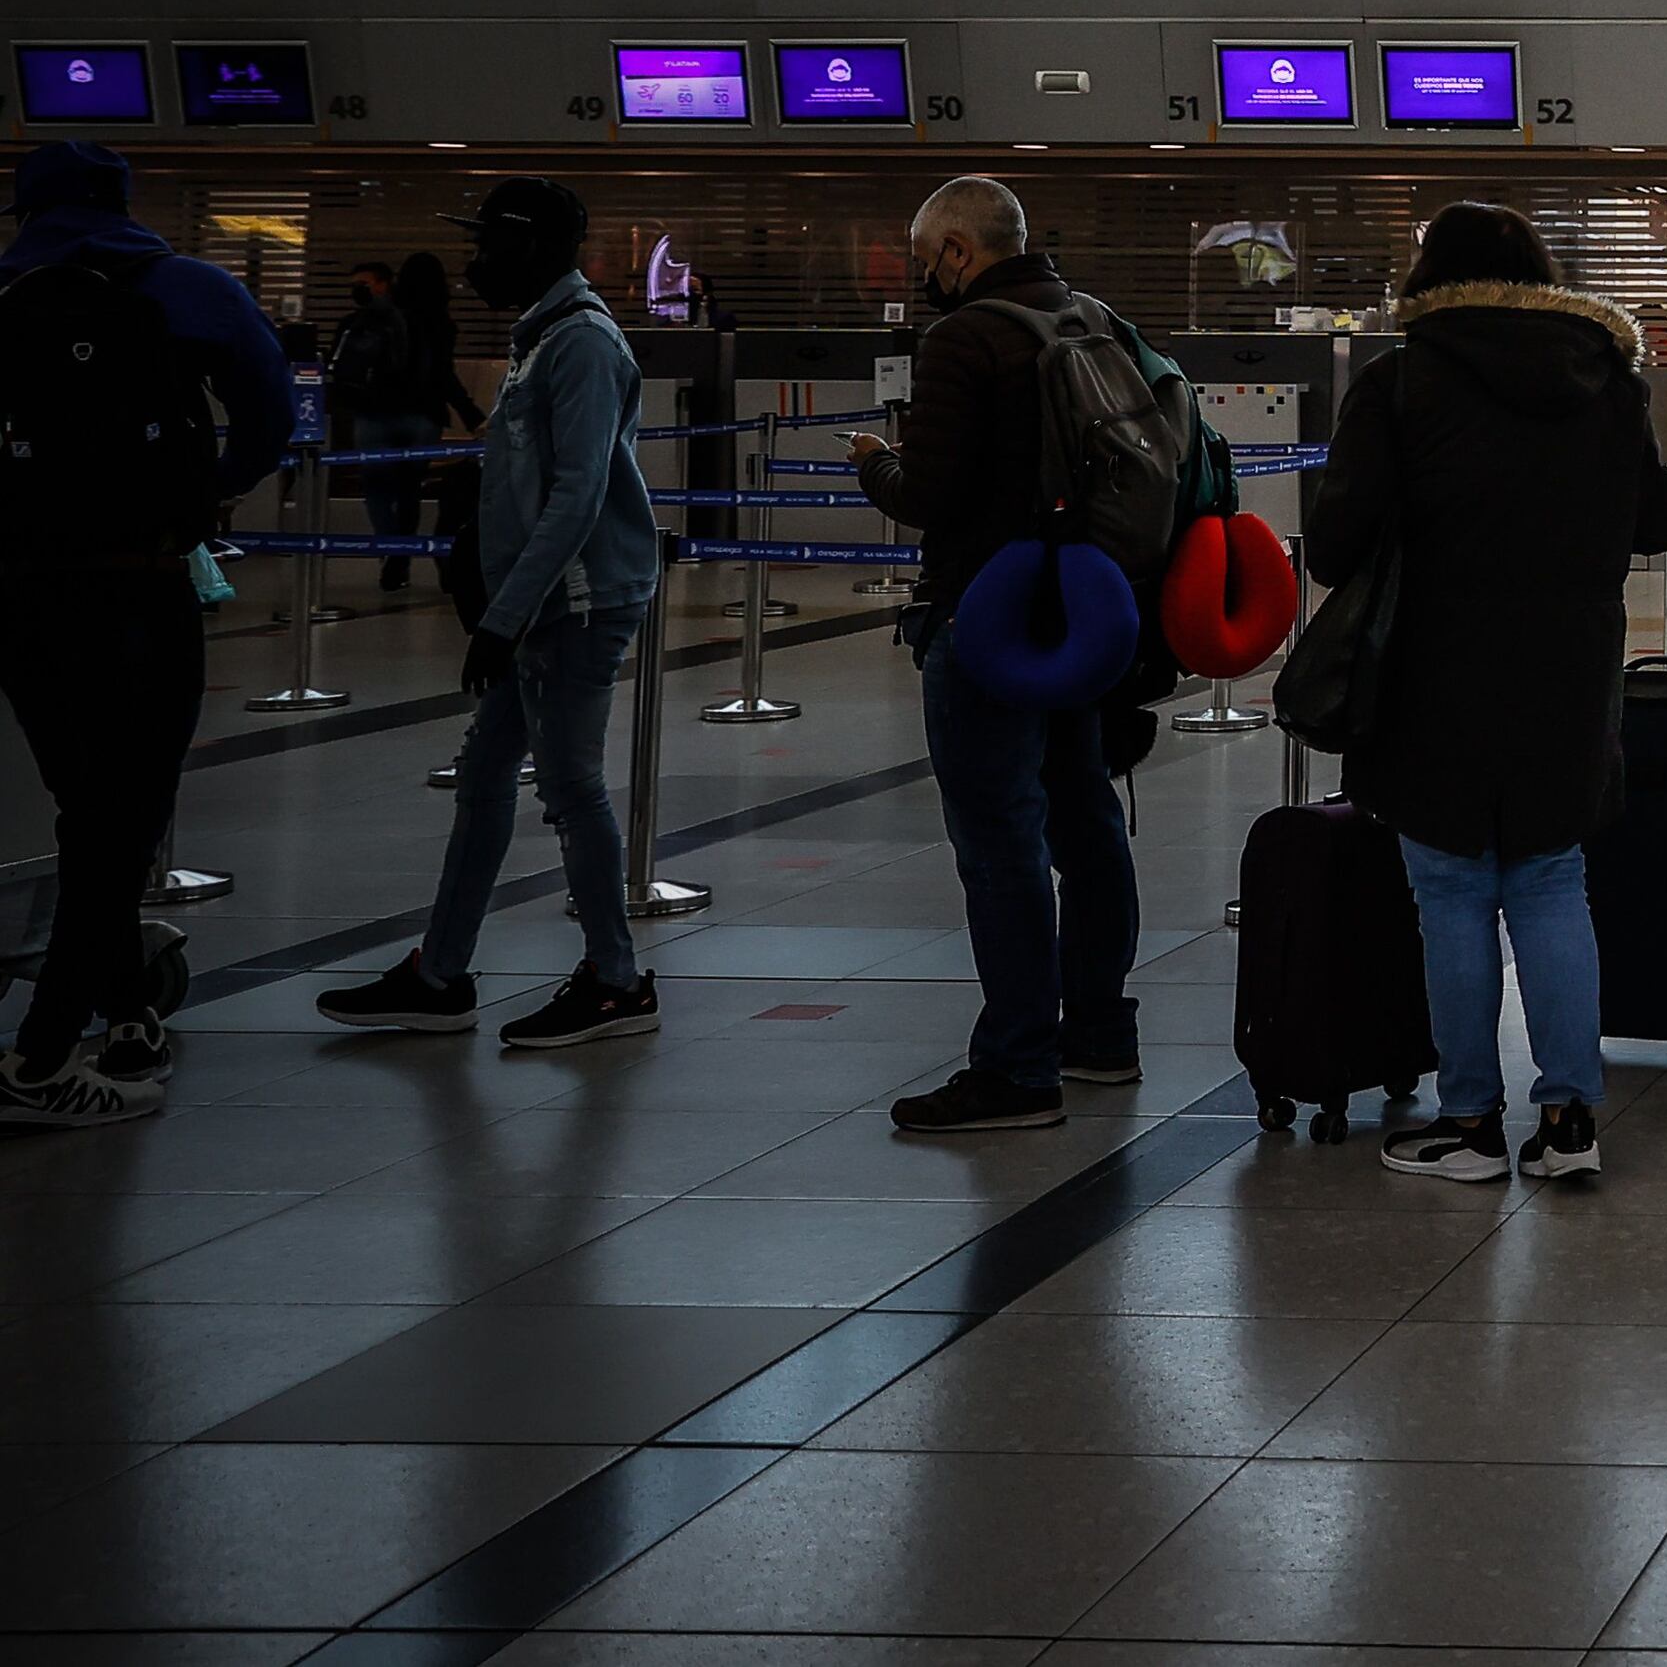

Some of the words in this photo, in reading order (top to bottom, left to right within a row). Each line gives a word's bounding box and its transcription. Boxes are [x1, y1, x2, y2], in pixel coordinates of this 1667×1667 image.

[329, 95, 367, 120] 48
[567, 96, 604, 121] 49
[926, 96, 963, 121] 50
[1168, 96, 1200, 121] 51
[1536, 99, 1574, 124] 52
